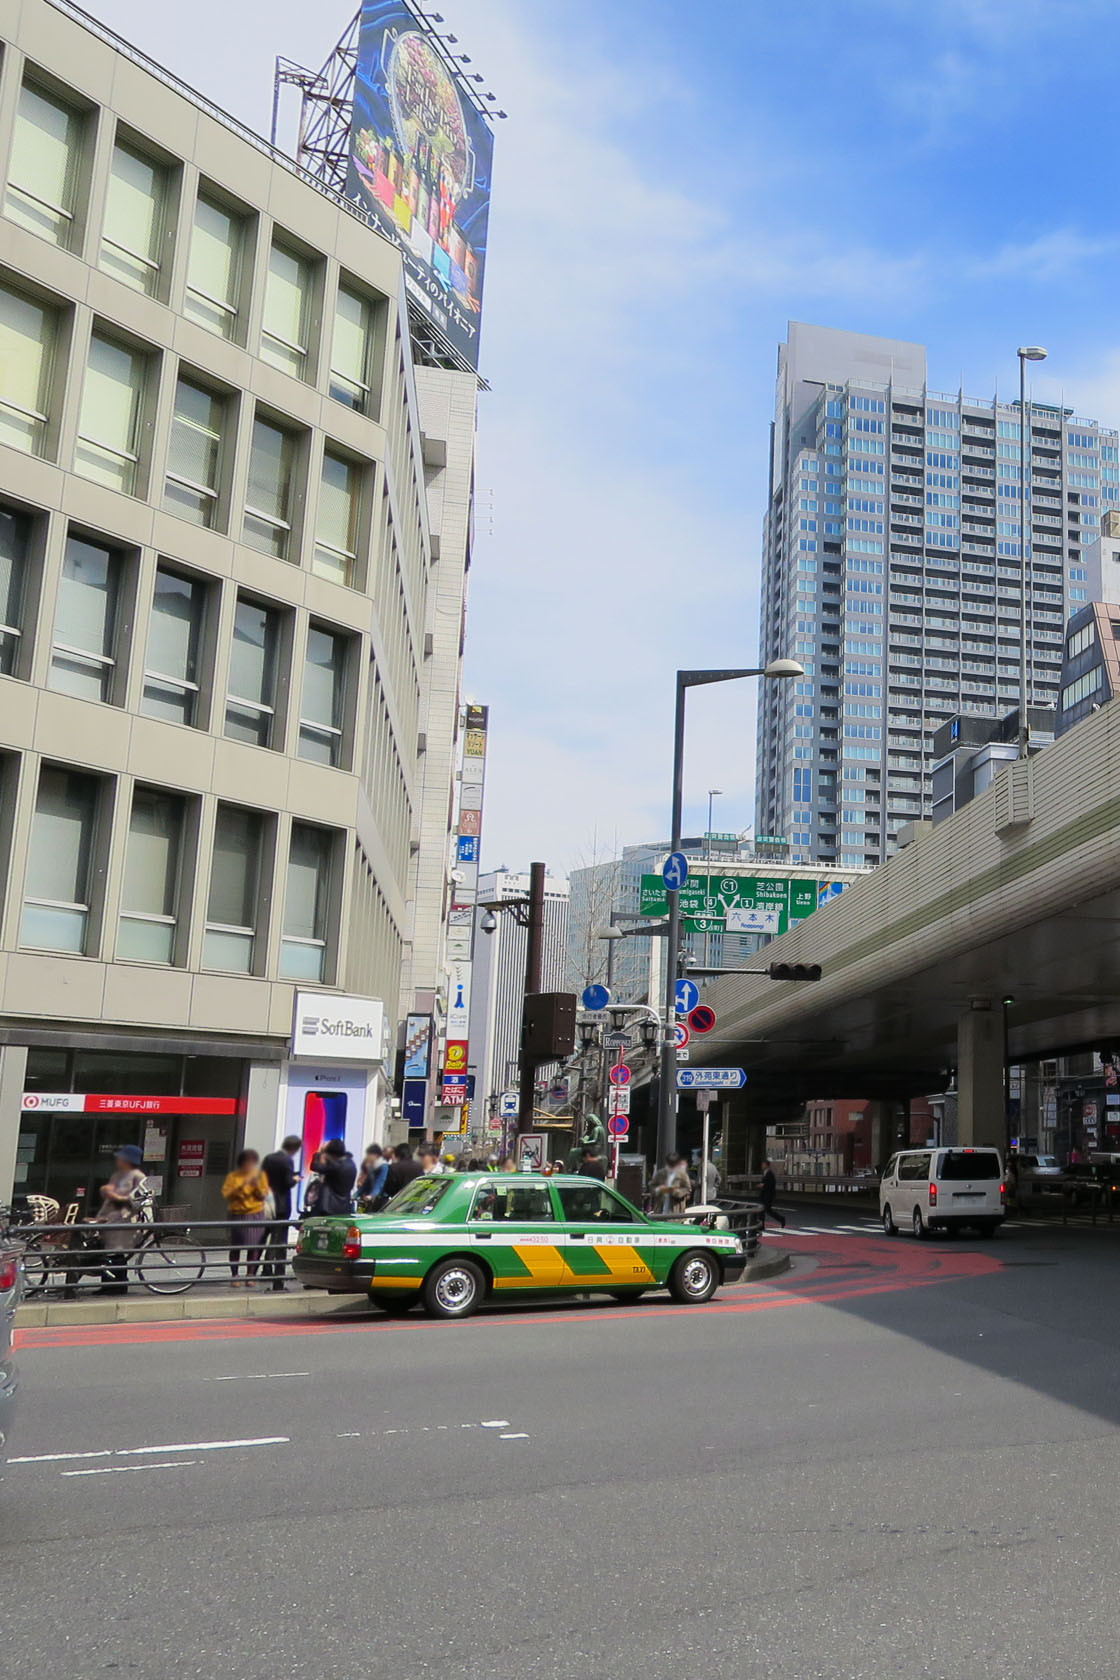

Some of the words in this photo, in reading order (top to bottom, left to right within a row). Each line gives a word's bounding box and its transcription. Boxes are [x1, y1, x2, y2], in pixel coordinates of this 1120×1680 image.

[756, 882, 784, 891] 芝公園
[732, 912, 774, 923] 六本木
[700, 920, 706, 928] 3
[320, 1019, 373, 1038] SoftBank
[445, 1061, 465, 1069] Daily
[695, 1072, 737, 1080] 外苑東通り
[41, 1094, 69, 1107] MUFG
[99, 1099, 160, 1109] 三菱東京UFJ銀行
[443, 1095, 464, 1104] ATM
